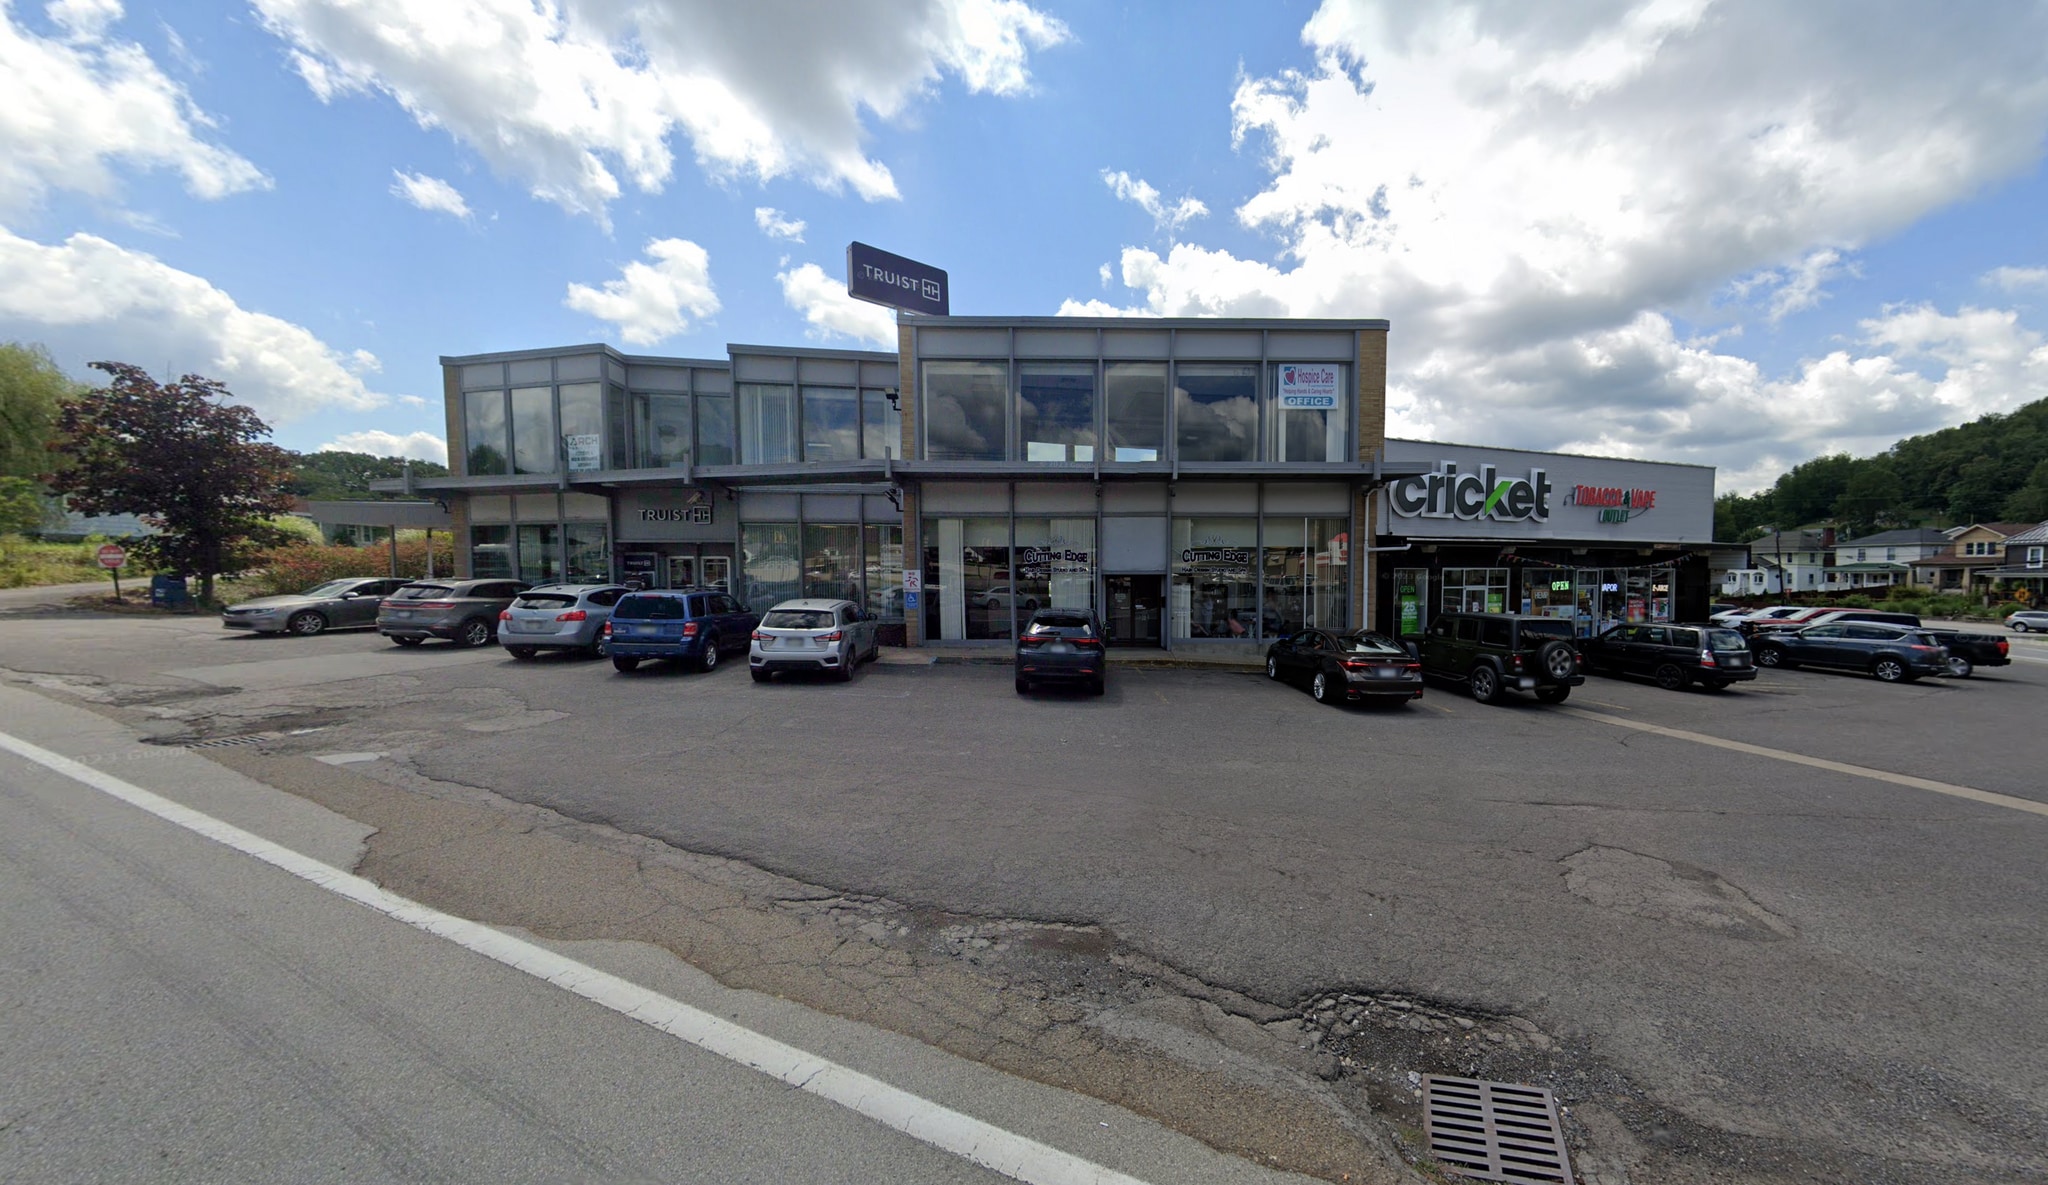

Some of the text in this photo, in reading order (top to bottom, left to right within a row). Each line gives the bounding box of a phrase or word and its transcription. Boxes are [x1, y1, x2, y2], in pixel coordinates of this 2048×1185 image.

[863, 264, 918, 291] TRUIST
[1298, 368, 1333, 387] Hospice Care
[1288, 397, 1329, 405] OFFICE
[1394, 463, 1552, 519] cricket
[1575, 485, 1656, 508] TOBACCO & VAPE
[638, 509, 690, 521] TRUIST
[1601, 509, 1630, 523] OUTLET
[1400, 585, 1415, 593] OPEN
[1552, 581, 1570, 591] OPEN
[1534, 591, 1549, 599] HEMP
[1403, 601, 1416, 612] 25
